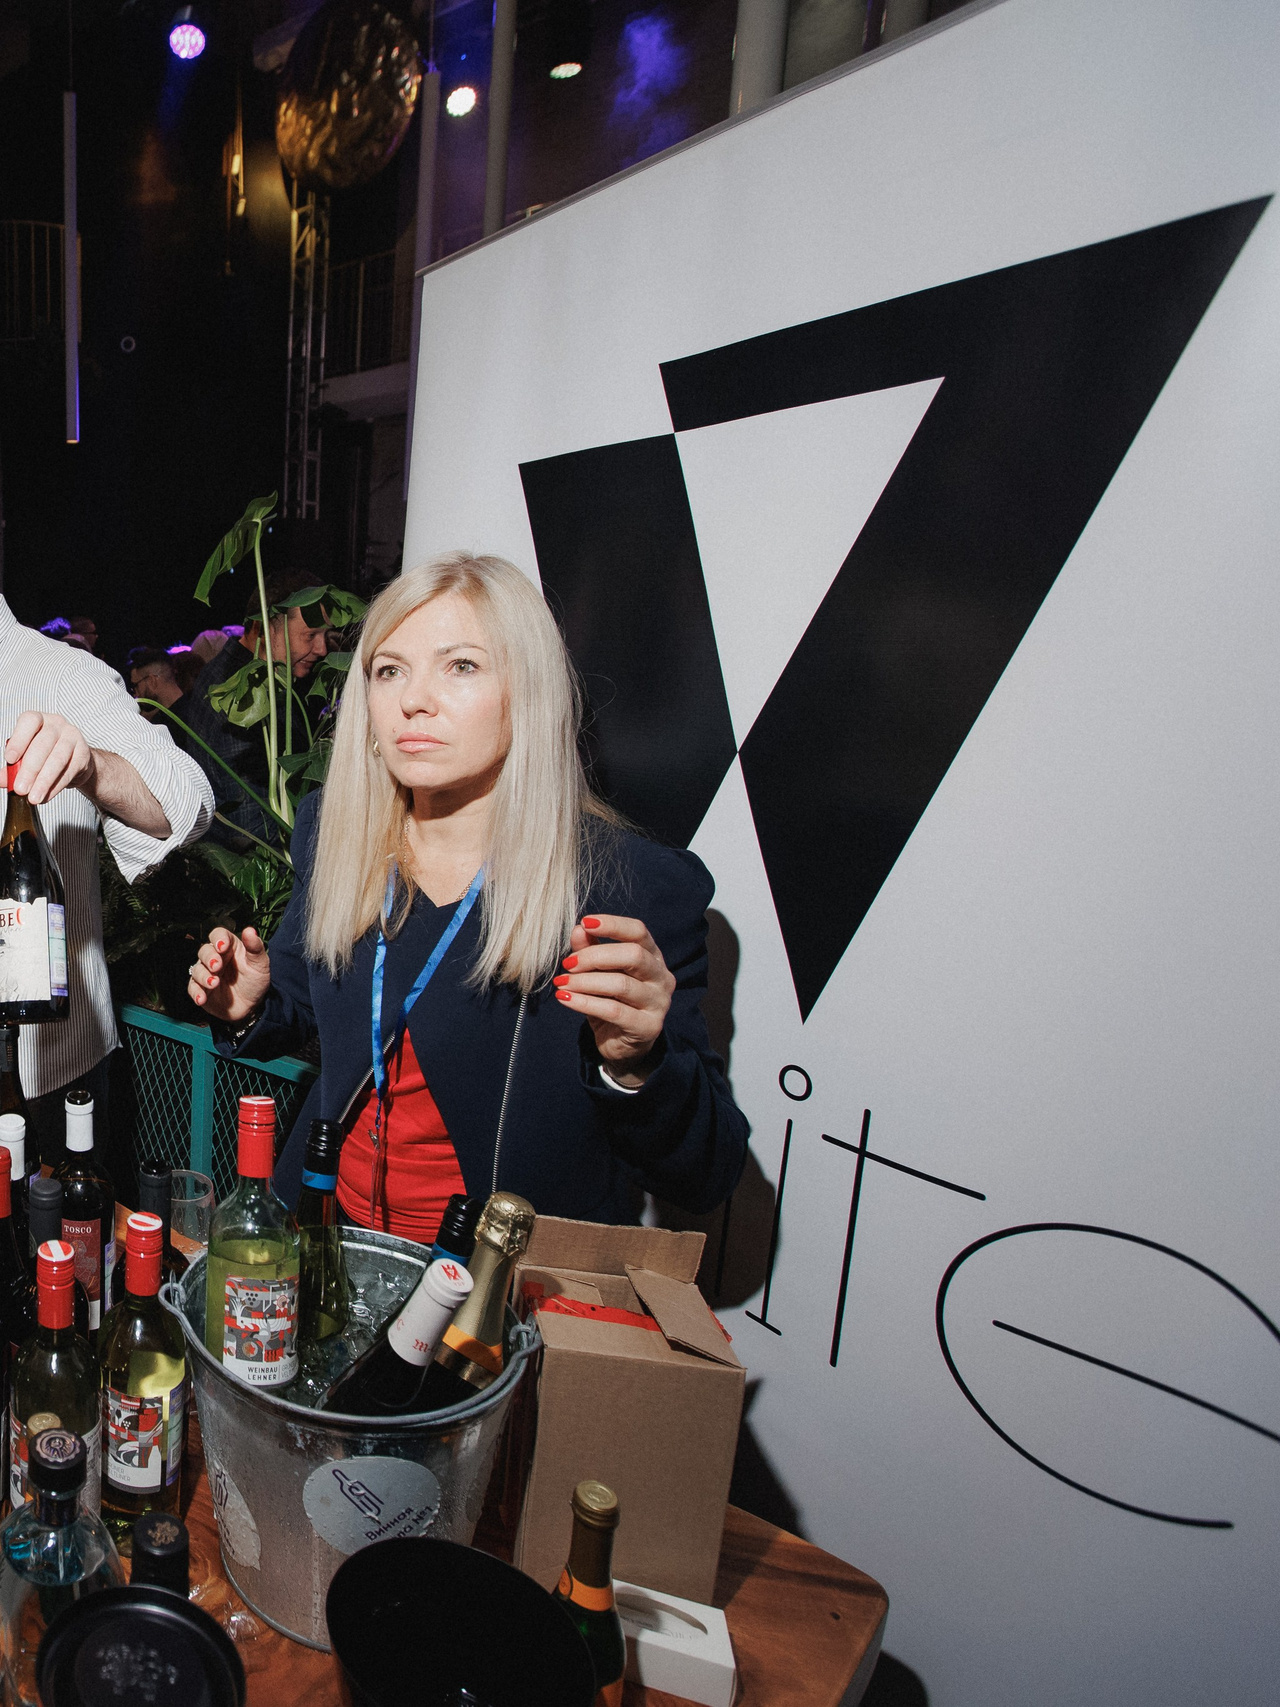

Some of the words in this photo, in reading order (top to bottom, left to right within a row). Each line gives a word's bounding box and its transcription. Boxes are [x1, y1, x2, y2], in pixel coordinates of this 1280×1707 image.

[63, 1224, 92, 1234] TOSCO
[717, 1064, 1280, 1530] ite
[247, 1366, 278, 1374] WEINBAU
[365, 1507, 415, 1541] Винная
